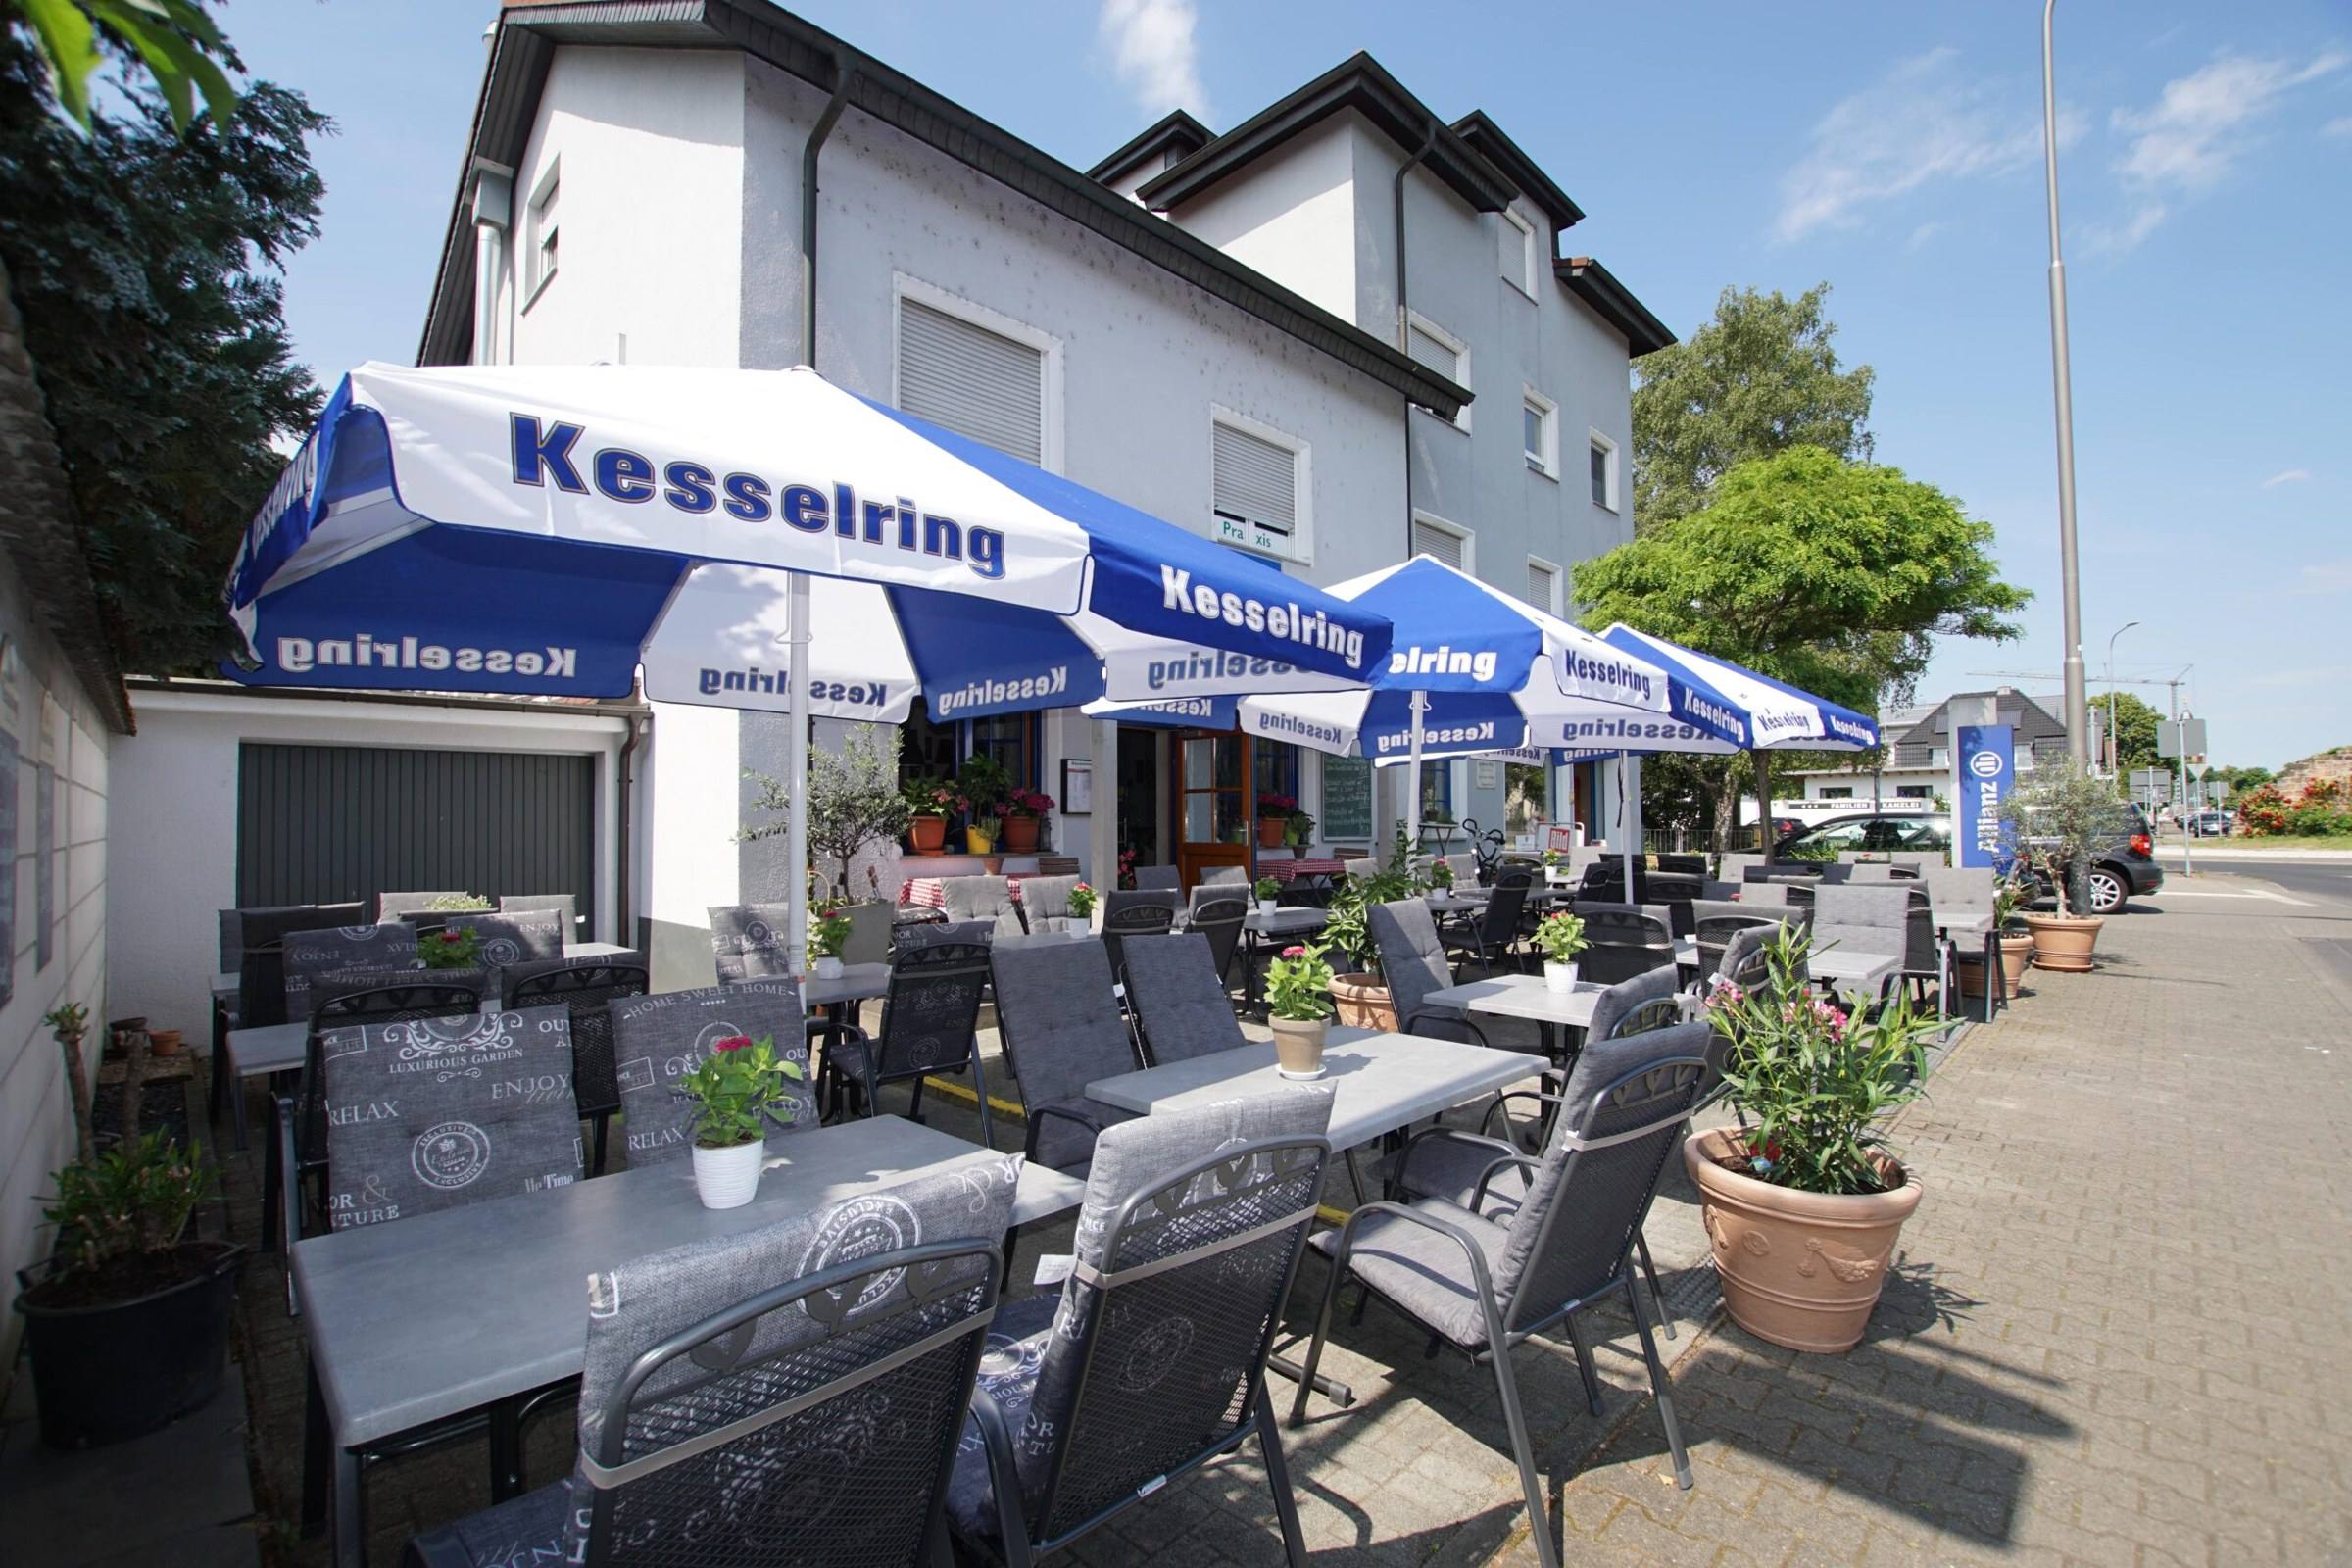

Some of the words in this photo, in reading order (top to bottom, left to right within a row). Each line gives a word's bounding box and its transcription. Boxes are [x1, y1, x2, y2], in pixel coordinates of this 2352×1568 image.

[509, 411, 1005, 580] Kesselring
[1223, 520, 1244, 540] Pra
[1256, 533, 1271, 548] xis
[1161, 564, 1365, 670] Kesselring
[1565, 648, 1651, 702] Kesselring
[1684, 687, 1745, 742] Kesselring
[1977, 780, 1999, 853] Allianz
[628, 996, 676, 1020] HOME
[682, 985, 736, 1003] SWEET
[743, 983, 787, 997] HOME
[389, 1054, 467, 1074] LUXURIOUS
[472, 1048, 524, 1065] GARDEN
[491, 1072, 570, 1100] ENJOY
[329, 1100, 400, 1127] RELAX
[628, 1127, 684, 1152] RELAX
